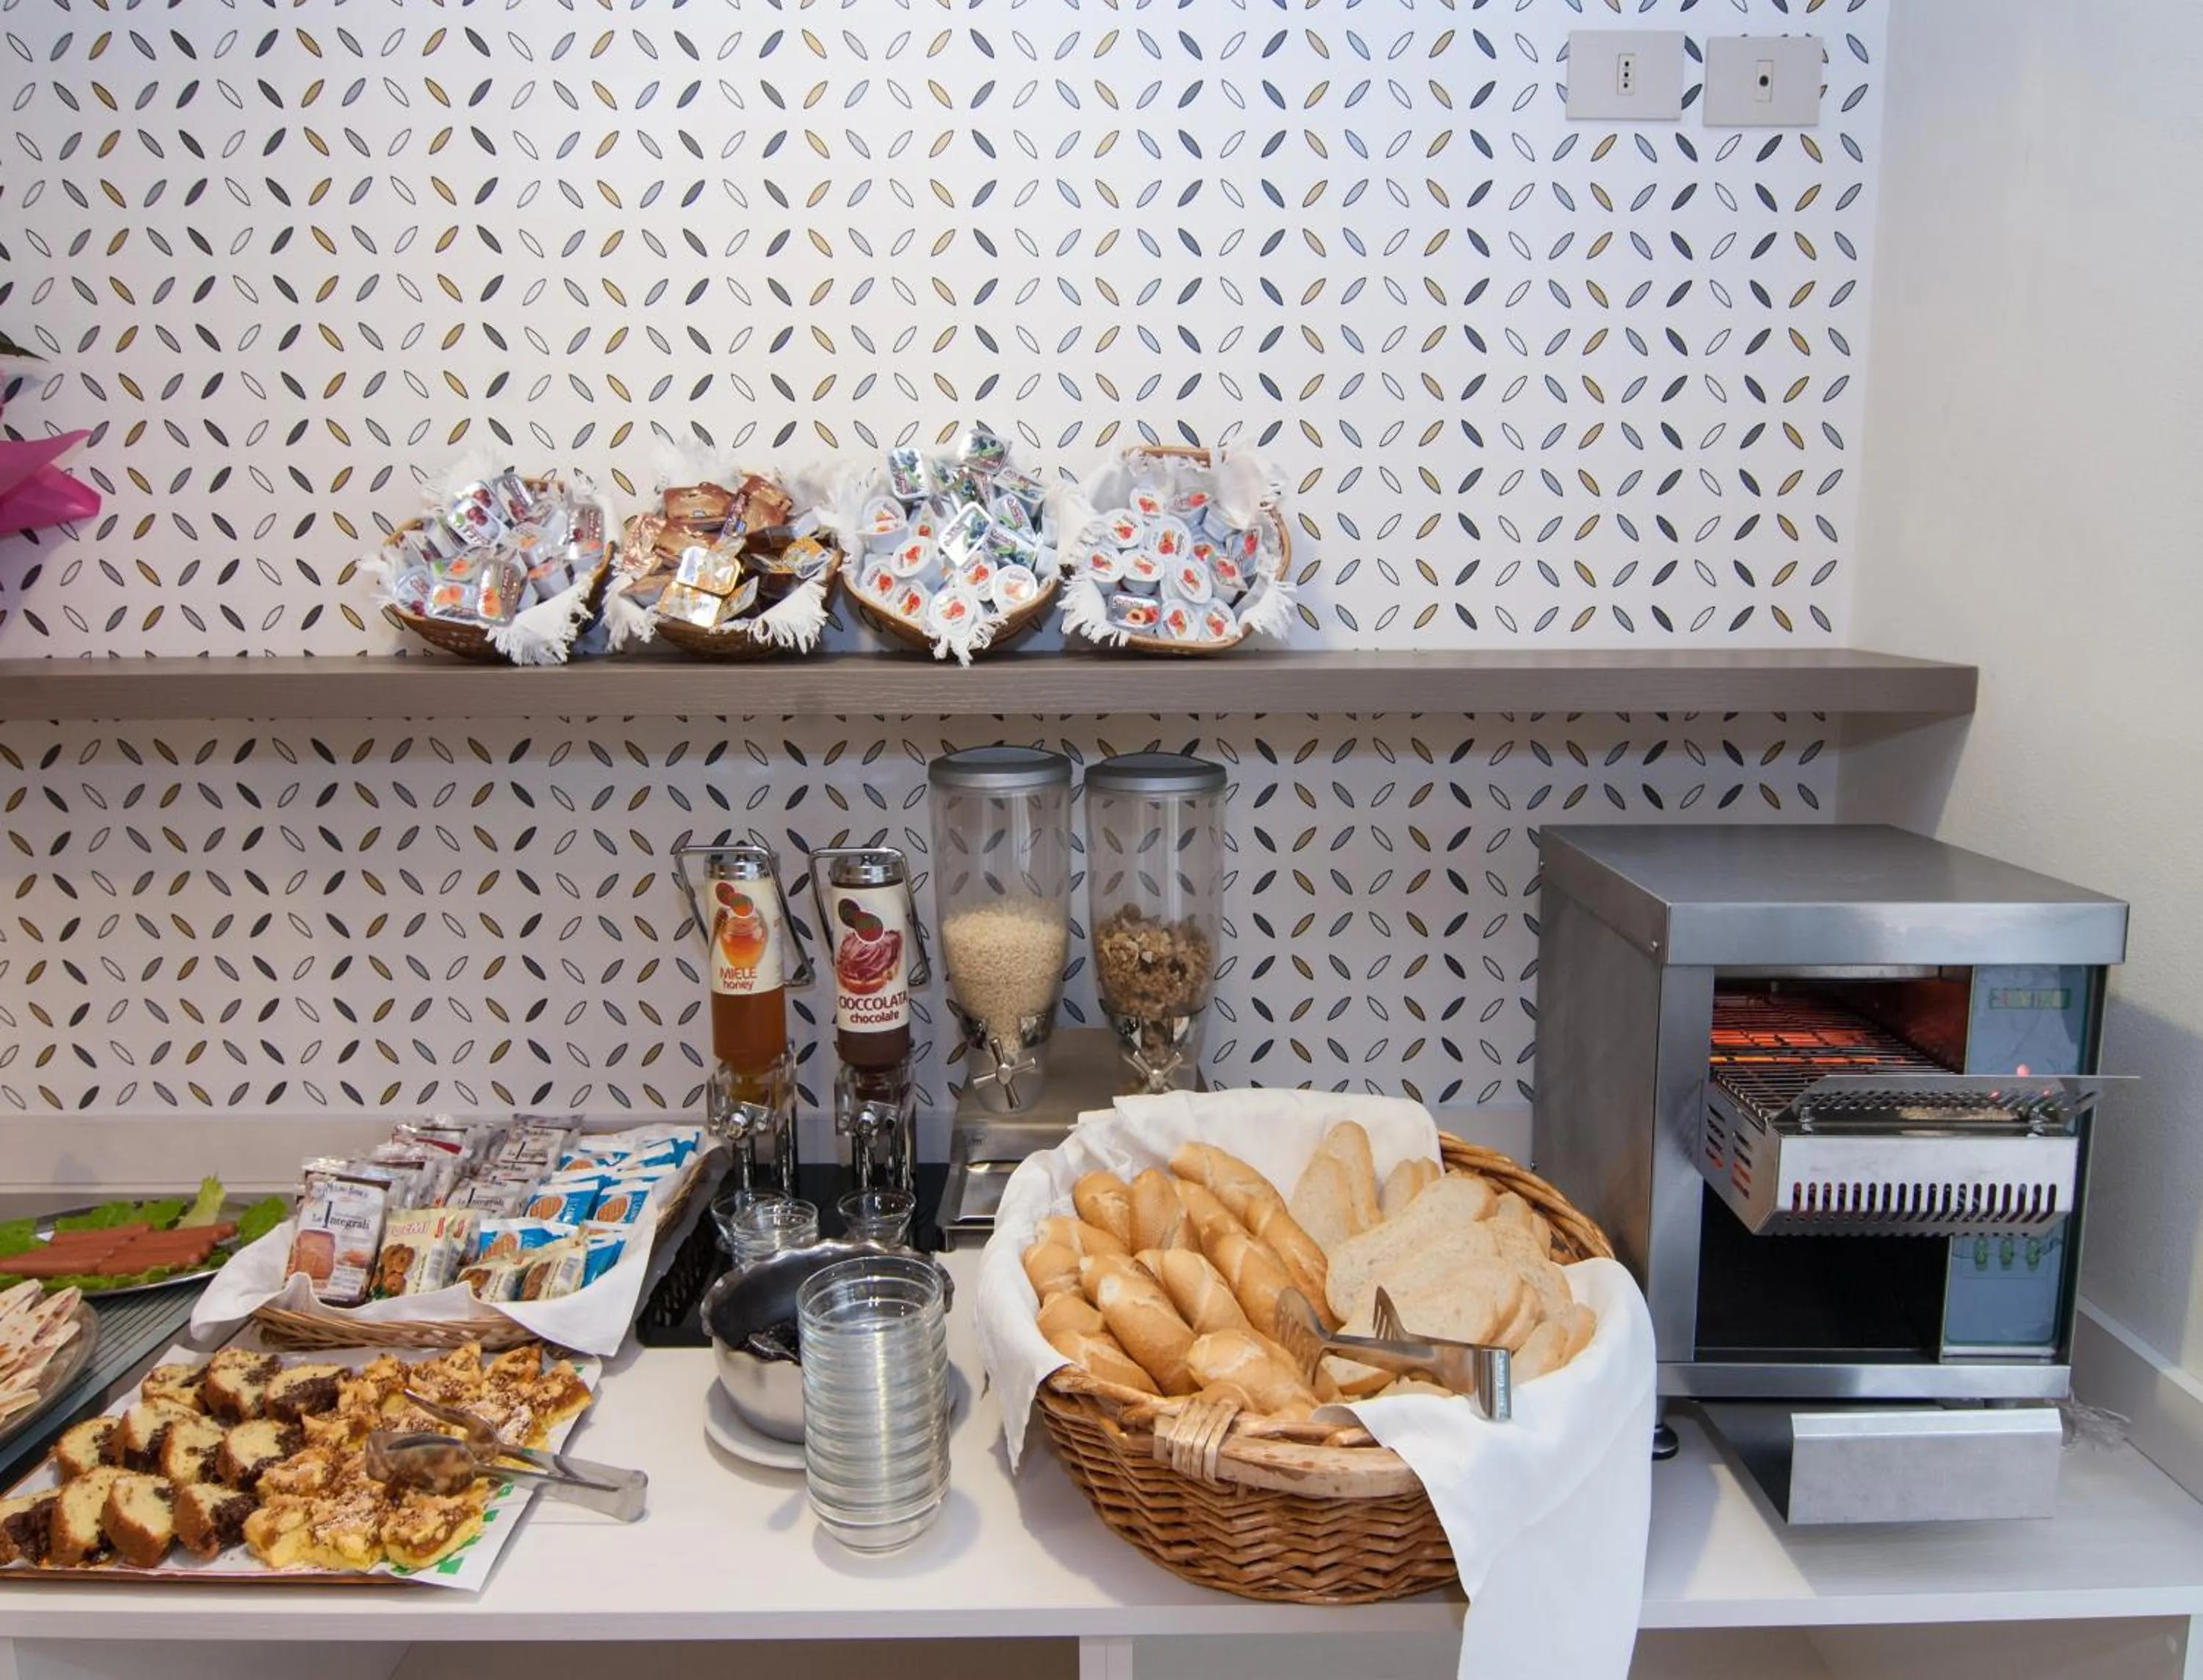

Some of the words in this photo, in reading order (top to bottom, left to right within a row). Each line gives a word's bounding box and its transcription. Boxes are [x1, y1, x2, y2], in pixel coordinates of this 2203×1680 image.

[720, 966, 757, 980] MIELE
[723, 979, 754, 991] honey
[850, 1010, 900, 1024] chocolate
[322, 1200, 371, 1230] Integrali
